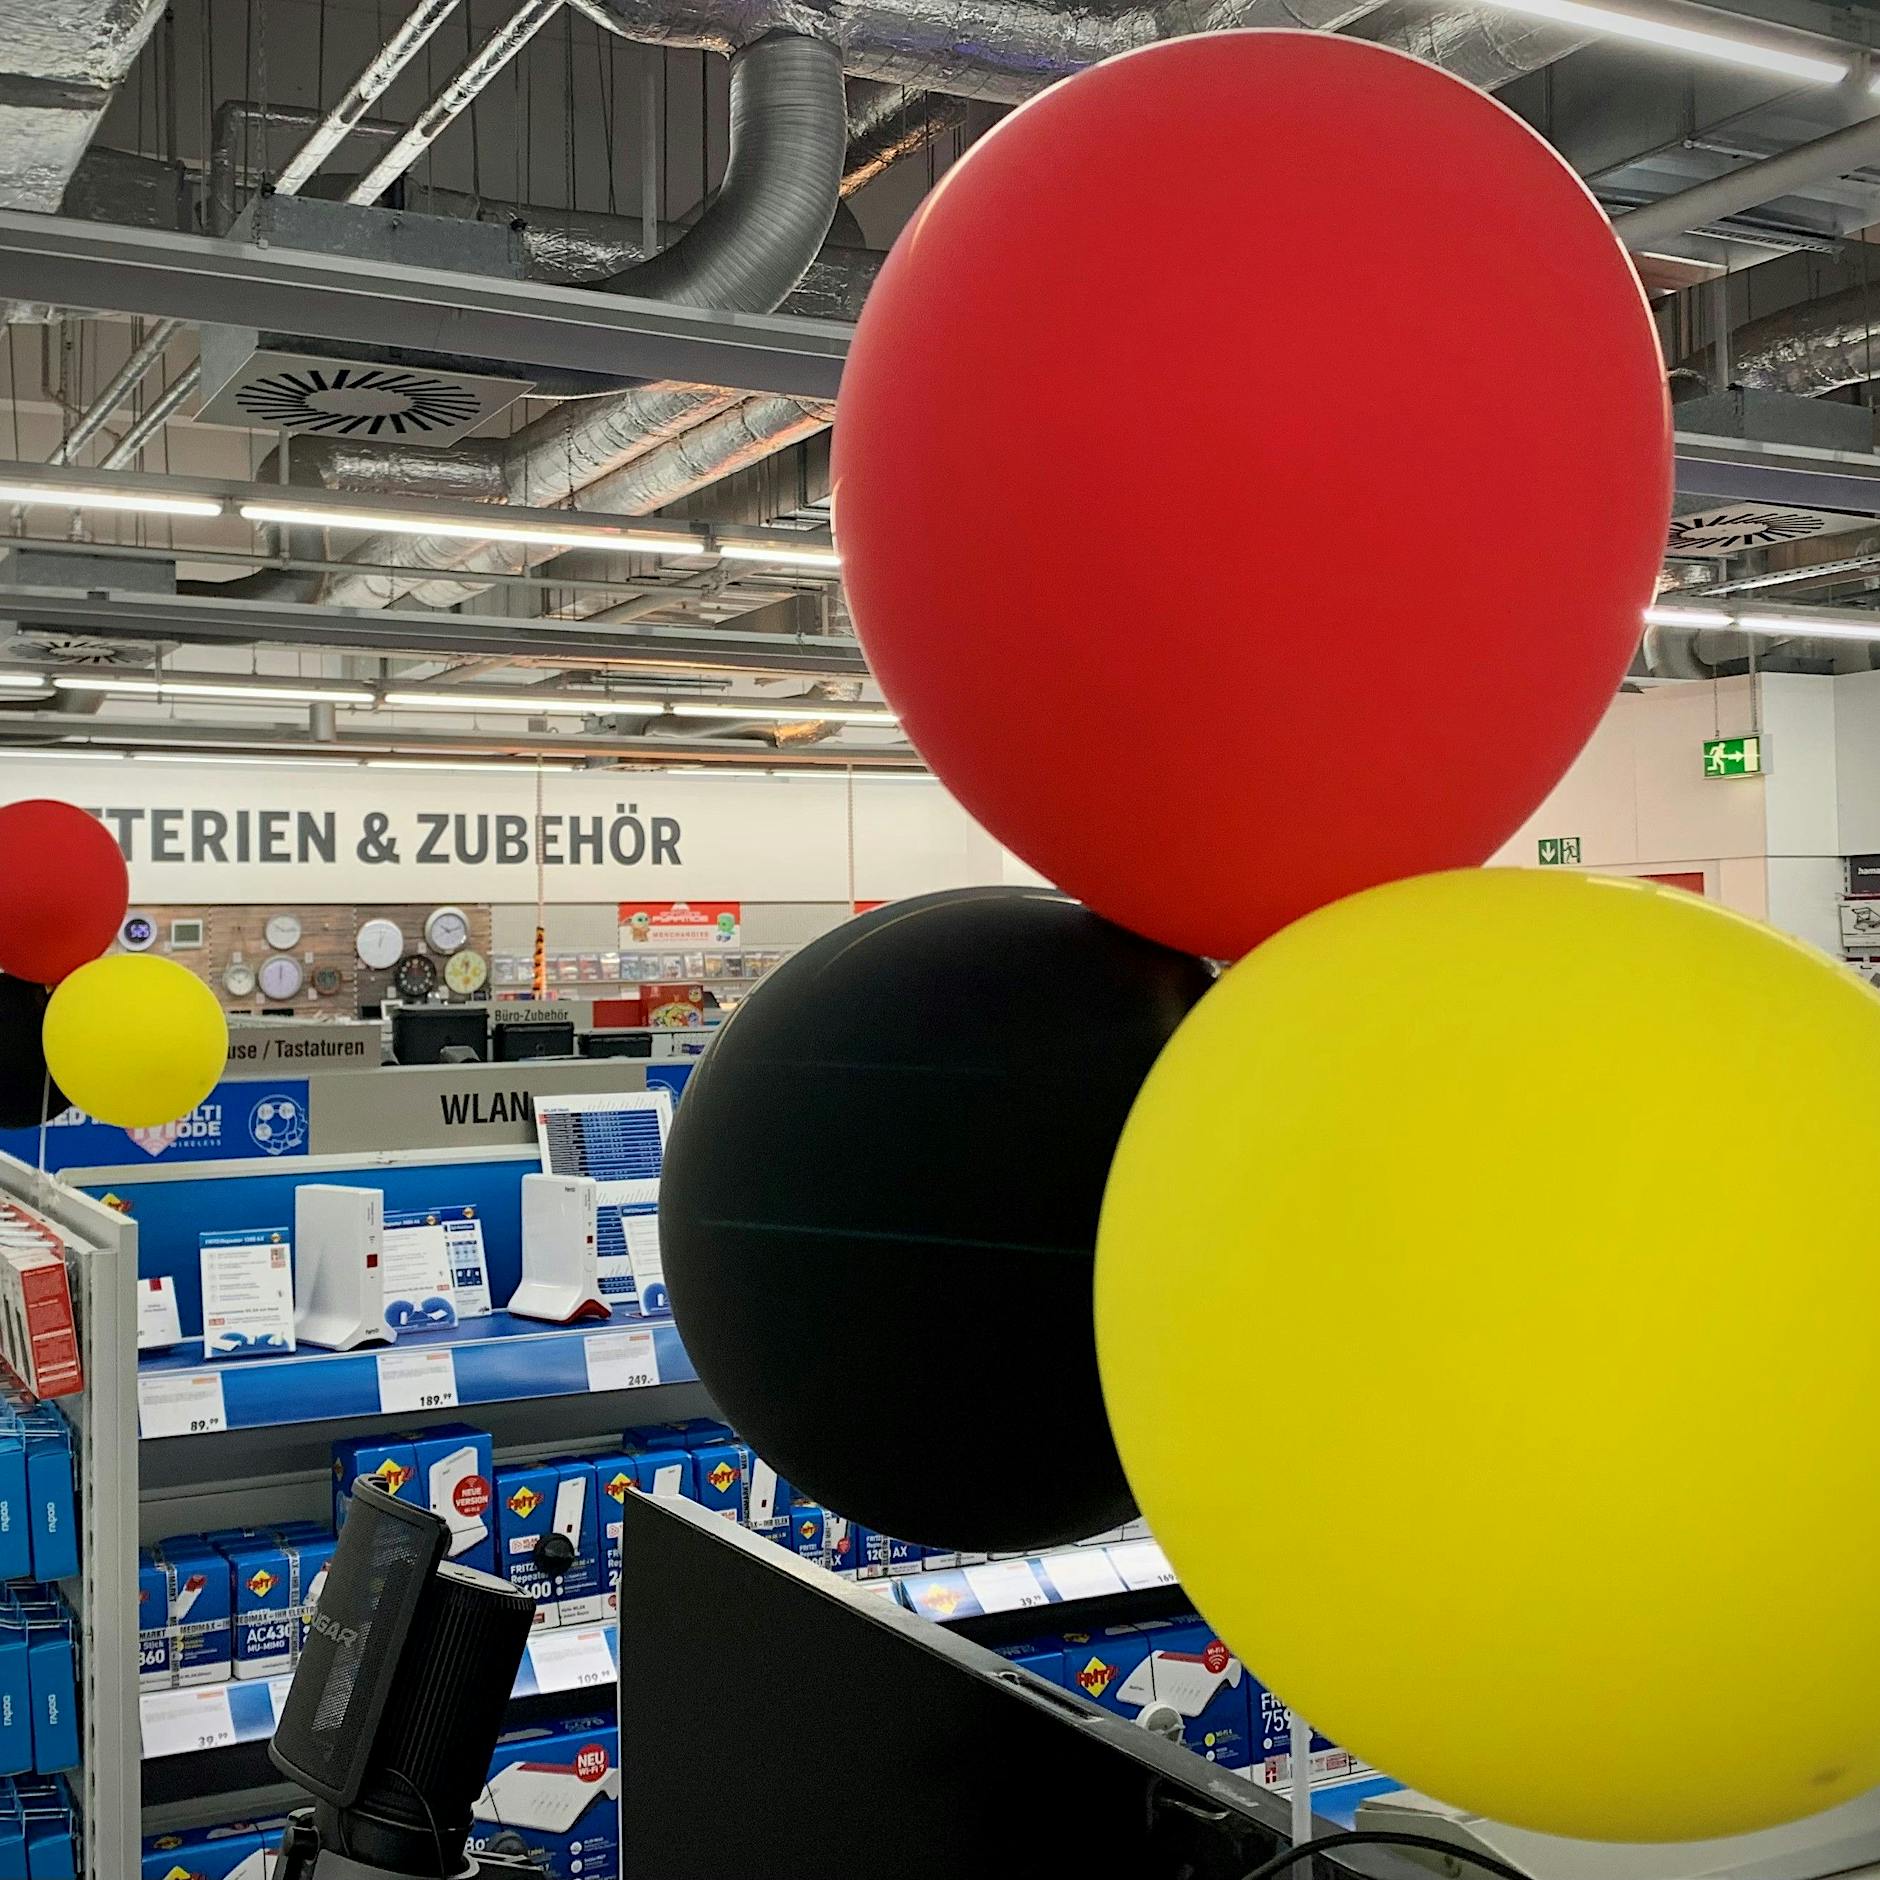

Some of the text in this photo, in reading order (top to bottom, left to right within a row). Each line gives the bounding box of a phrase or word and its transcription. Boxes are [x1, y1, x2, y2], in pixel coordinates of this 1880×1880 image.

[81, 803, 683, 866] TERIEN & ZUBEHÖR
[494, 1008, 569, 1022] Büro-Zubehör
[263, 1040, 271, 1060] /
[274, 1038, 365, 1059] Tastaturen
[440, 1090, 531, 1126] WLAN
[455, 1495, 489, 1507] VERSION
[461, 1486, 482, 1498] NEUE
[892, 1545, 908, 1559] AX
[1261, 1691, 1287, 1711] FR
[577, 1750, 605, 1770] NEU
